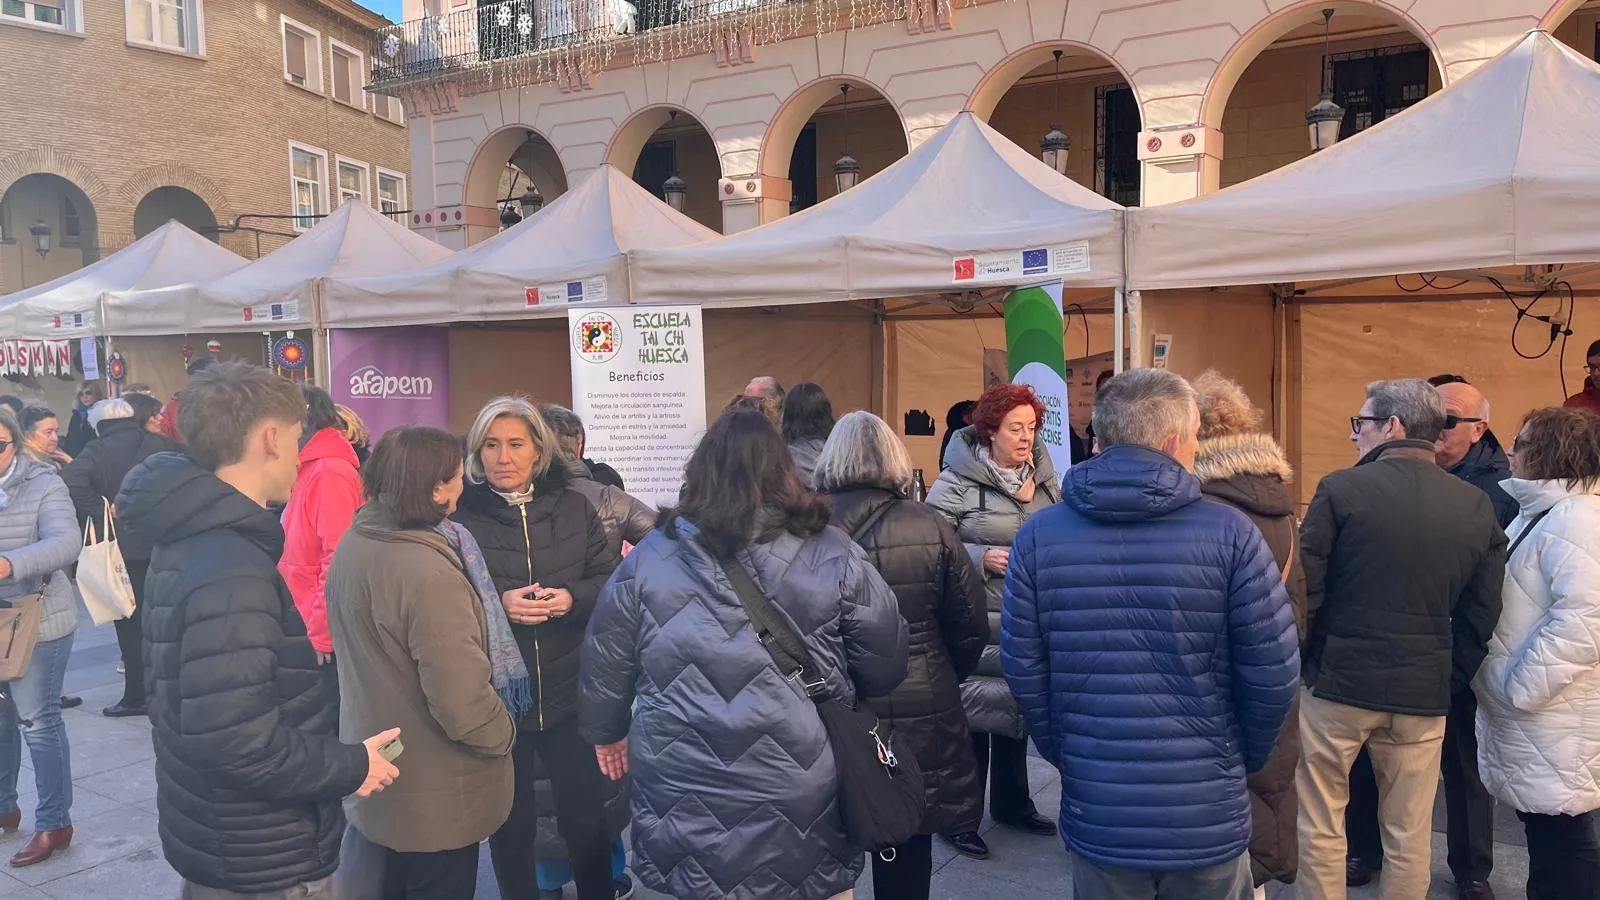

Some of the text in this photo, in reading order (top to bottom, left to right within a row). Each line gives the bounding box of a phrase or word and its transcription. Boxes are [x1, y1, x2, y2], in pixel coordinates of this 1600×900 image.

[987, 266, 1010, 274] Huesca
[633, 312, 691, 329] ESCUELA
[640, 330, 685, 346] TAI CHI
[638, 347, 689, 364] HUESCA
[609, 371, 665, 382] Beneficios
[349, 369, 433, 399] afapem
[609, 434, 631, 442] Mejora
[615, 444, 646, 452] capacidad
[628, 475, 650, 483] calidad
